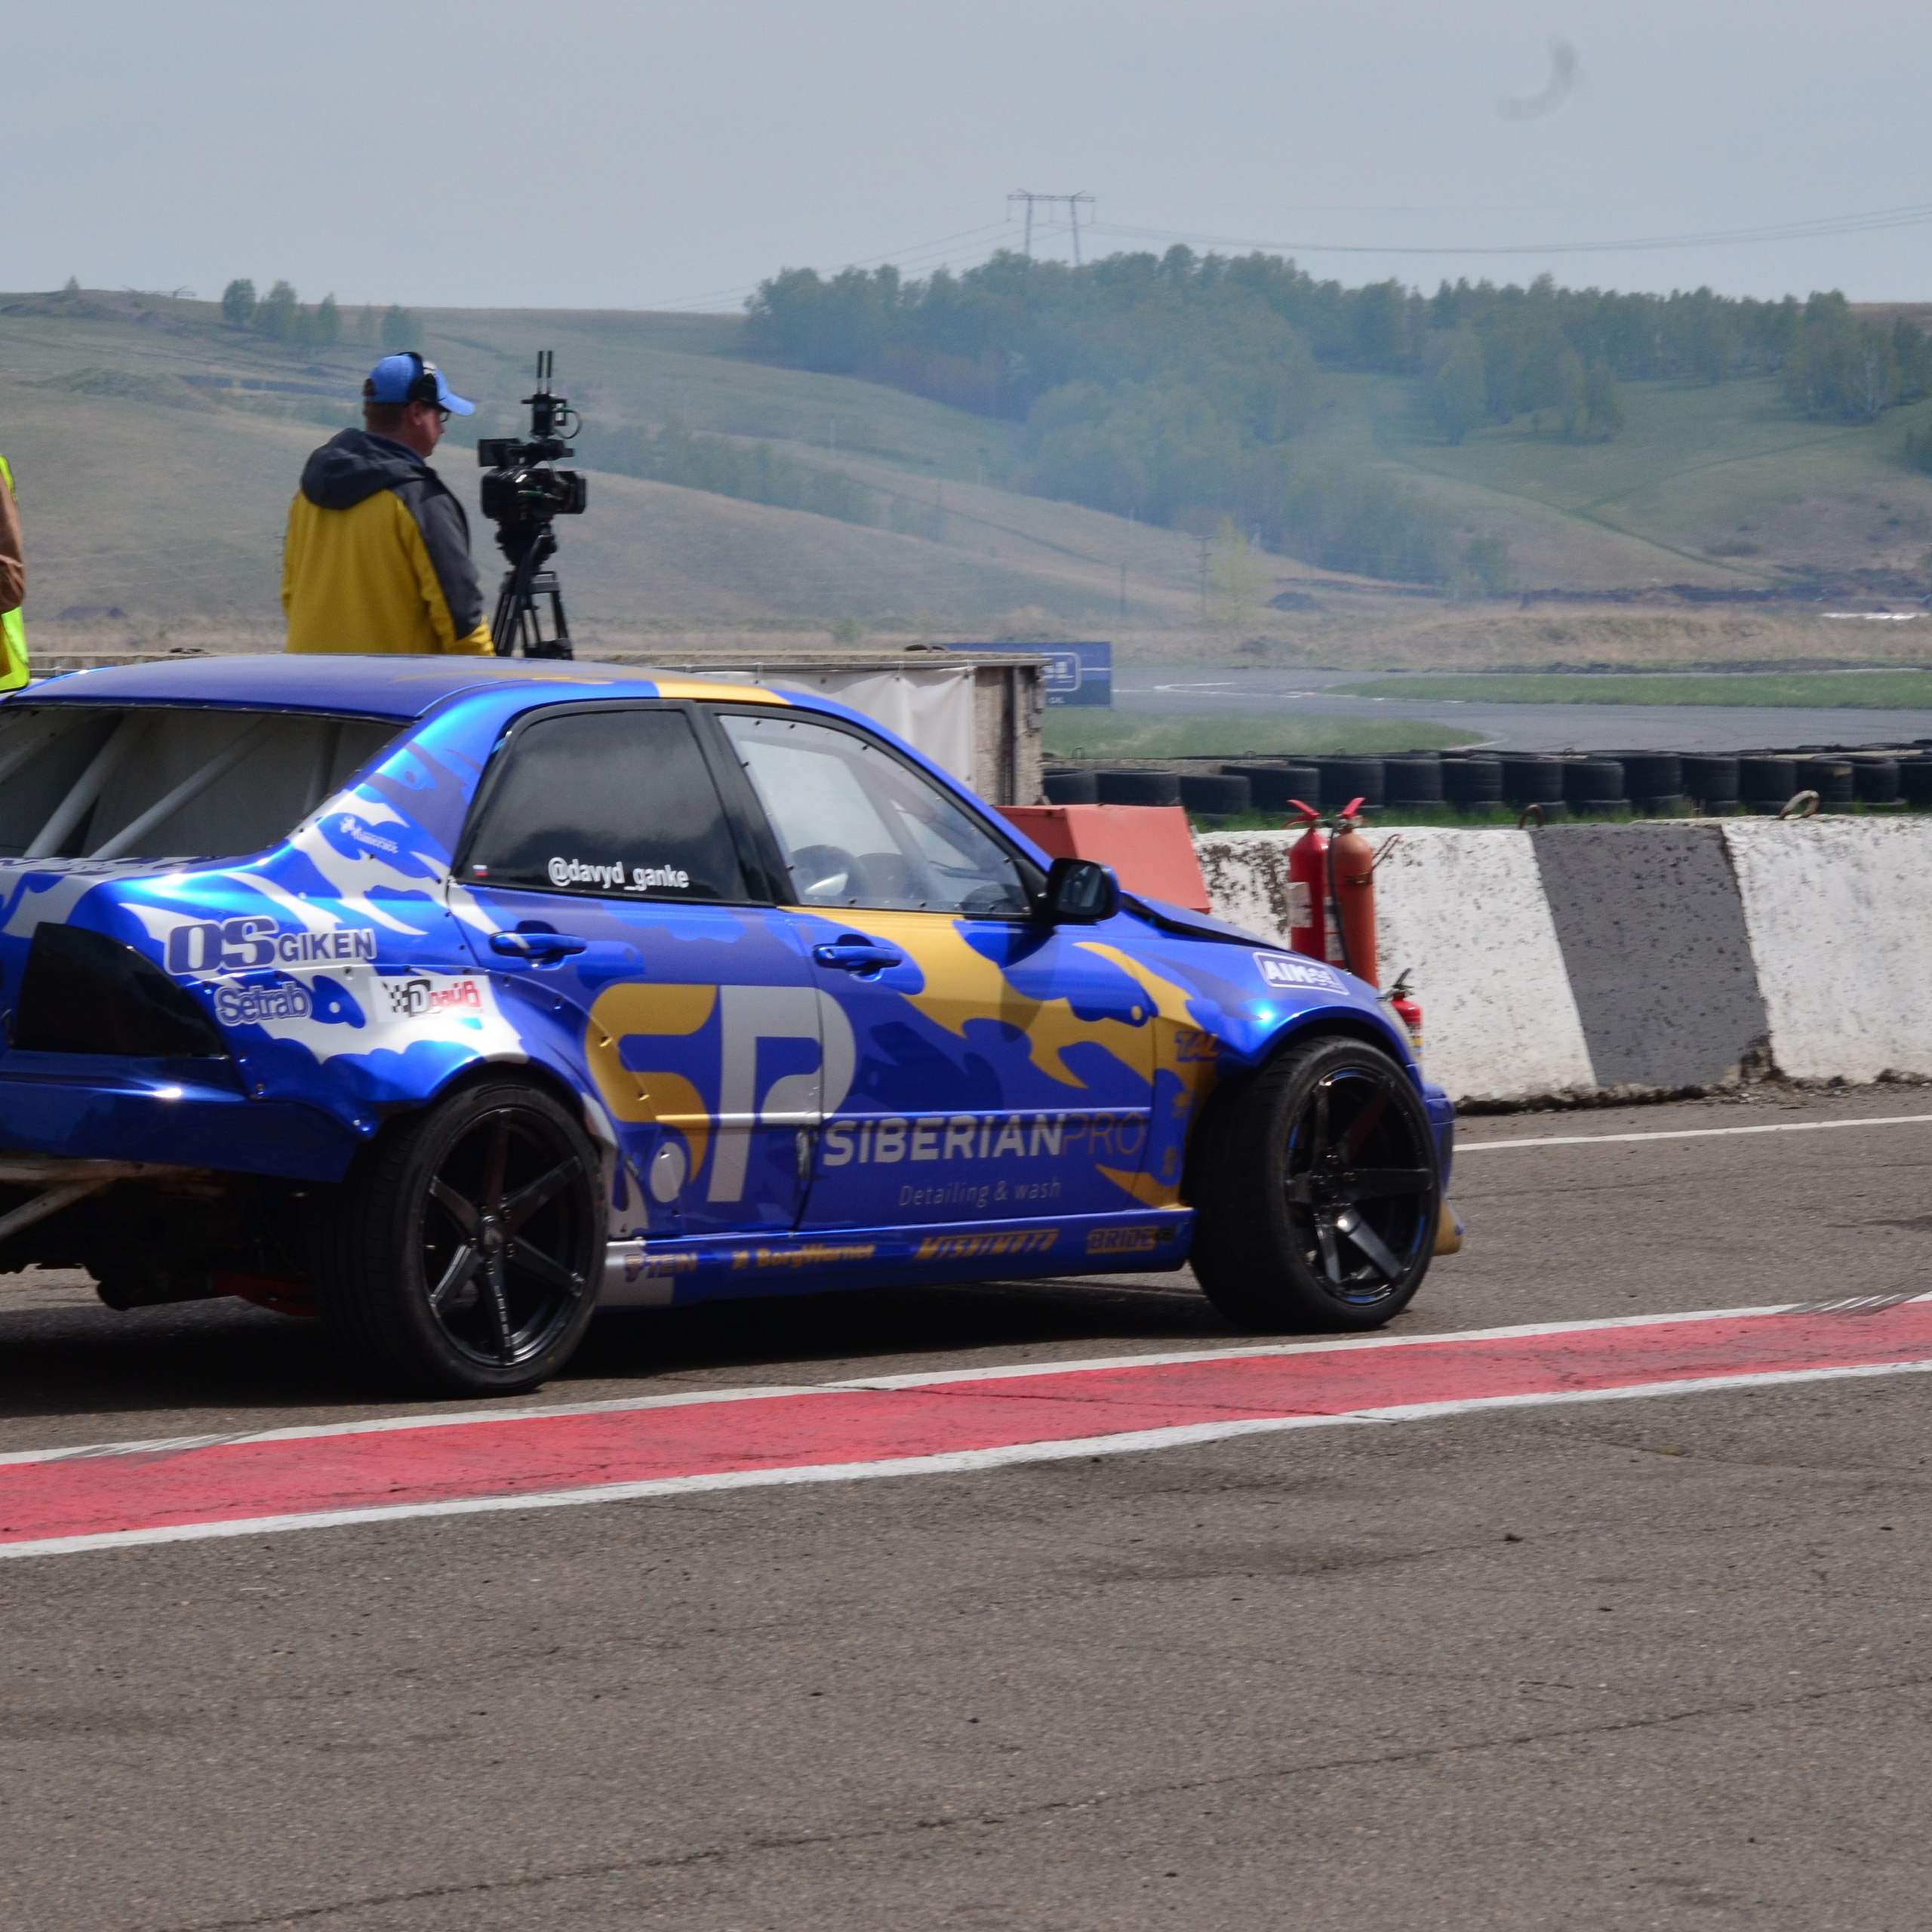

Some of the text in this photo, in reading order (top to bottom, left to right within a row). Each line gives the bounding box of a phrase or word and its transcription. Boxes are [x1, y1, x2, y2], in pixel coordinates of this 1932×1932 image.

[548, 857, 690, 891] @davyd_ganke
[167, 916, 374, 974] OS GIKEN
[214, 982, 312, 1026] Setrab
[899, 1177, 1061, 1208] Detailing & wash
